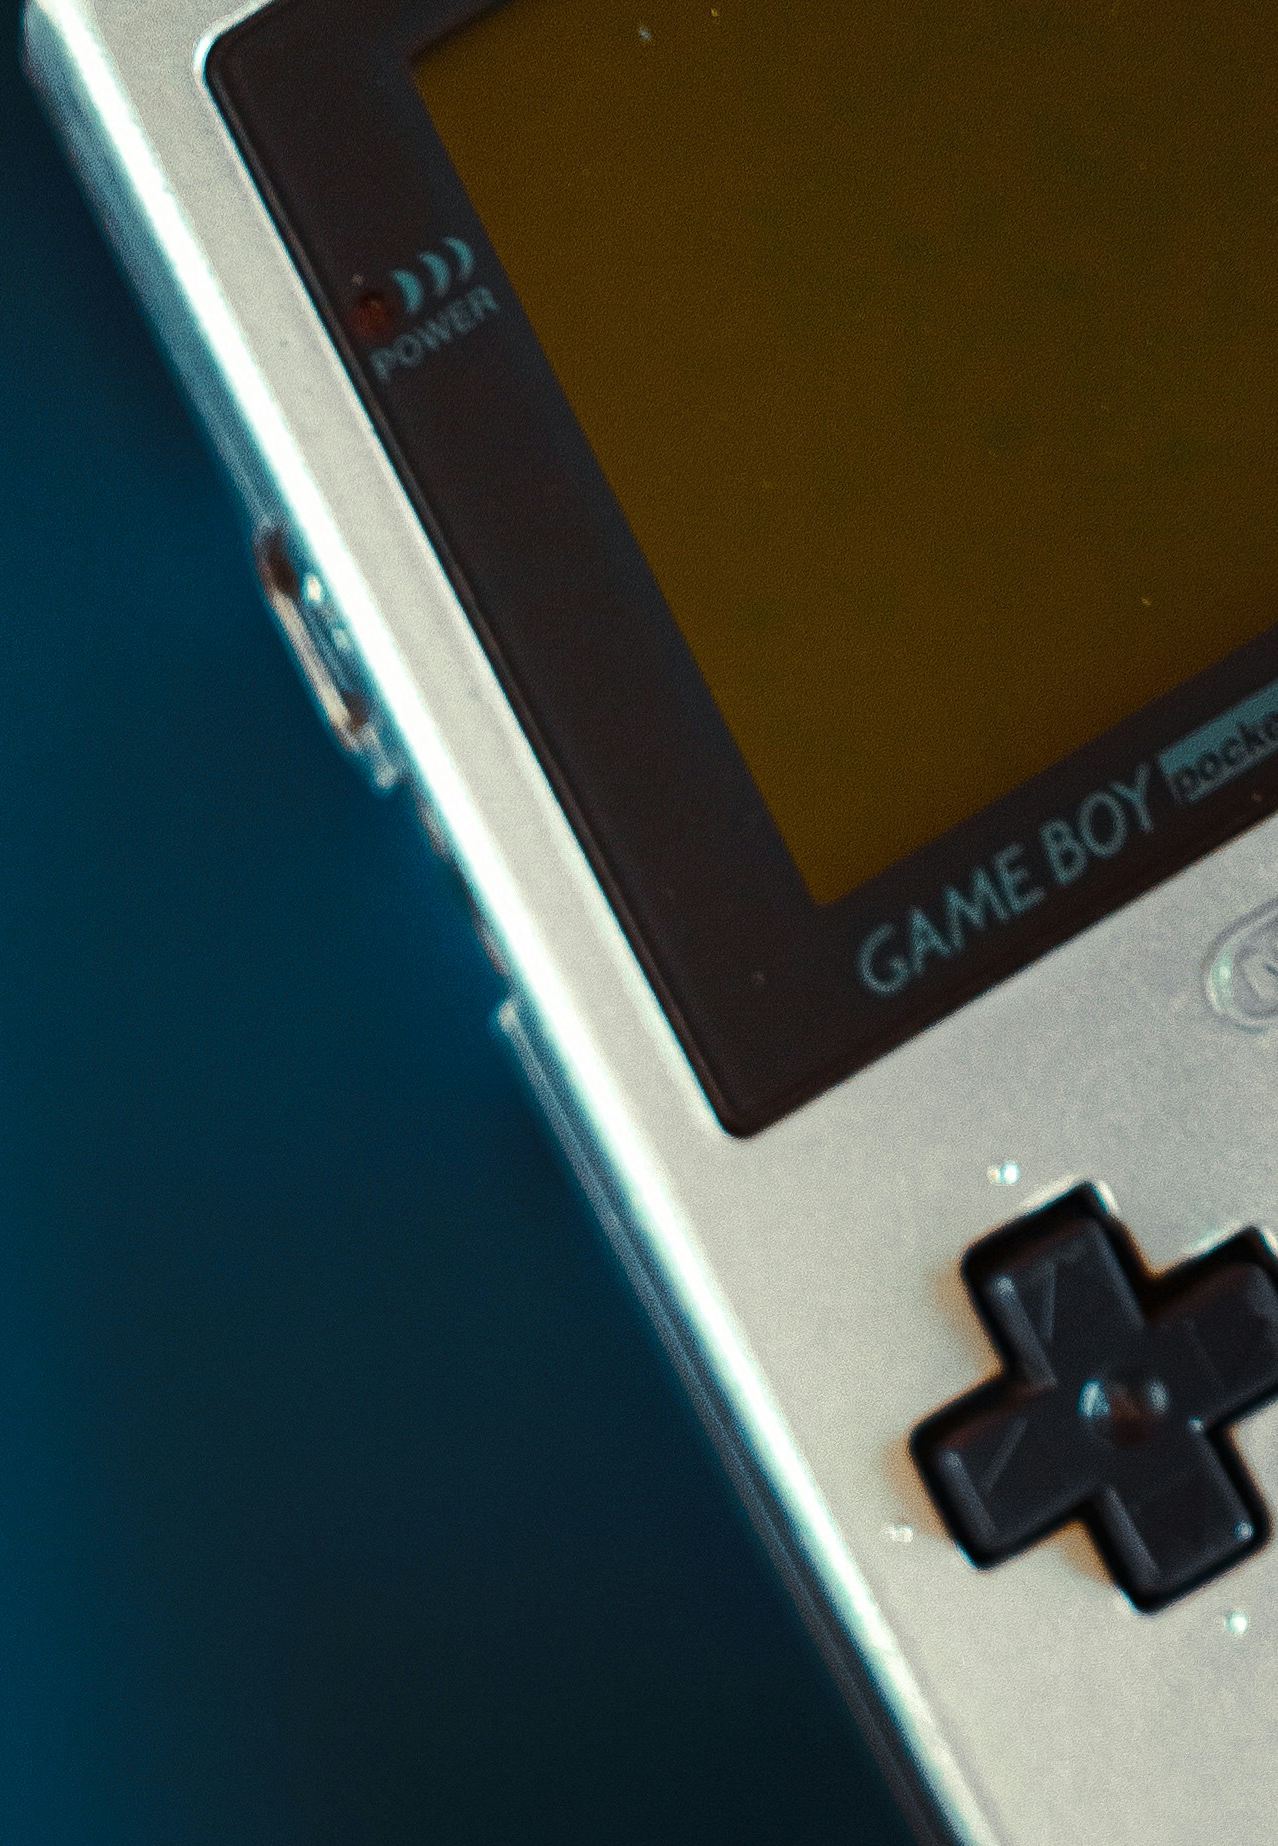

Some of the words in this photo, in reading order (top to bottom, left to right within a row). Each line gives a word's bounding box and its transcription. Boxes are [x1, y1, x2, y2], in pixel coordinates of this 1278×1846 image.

[370, 285, 500, 382] POWER
[856, 842, 1046, 997] GAME
[1039, 762, 1155, 886] BOY
